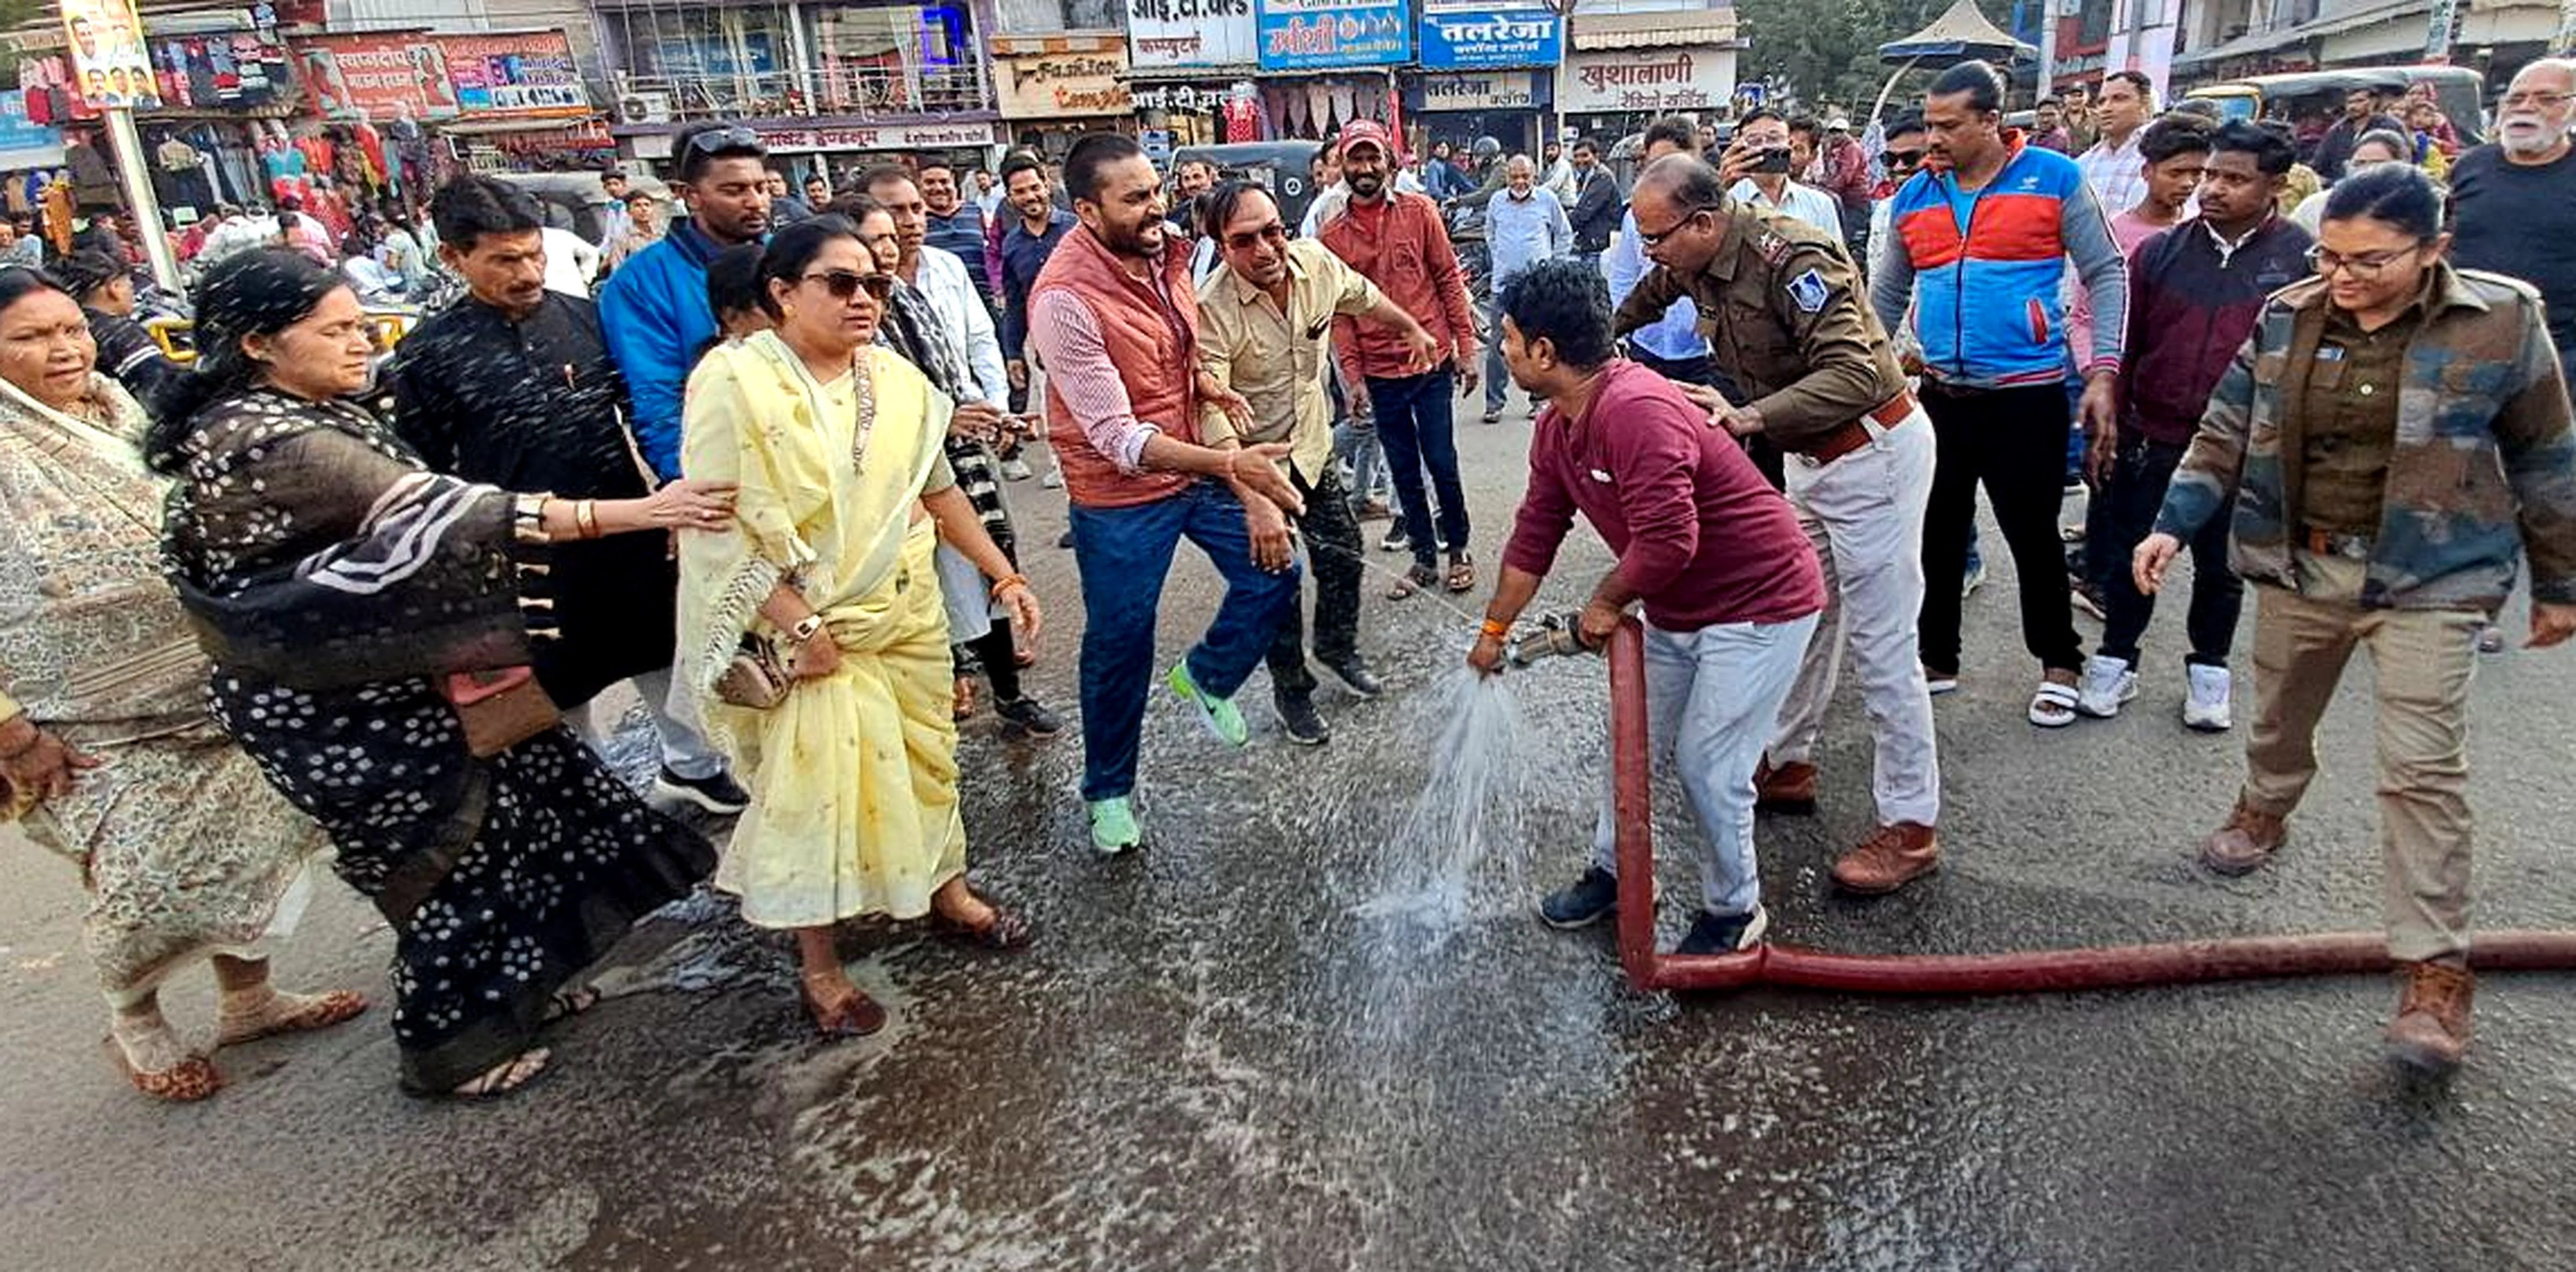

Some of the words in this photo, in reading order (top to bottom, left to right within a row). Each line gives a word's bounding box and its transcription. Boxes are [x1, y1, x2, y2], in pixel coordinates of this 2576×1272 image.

[1440, 14, 1554, 42] तलरेजा
[1427, 75, 1491, 97] तलरेजा
[1579, 53, 1693, 93] खुशालाणी
